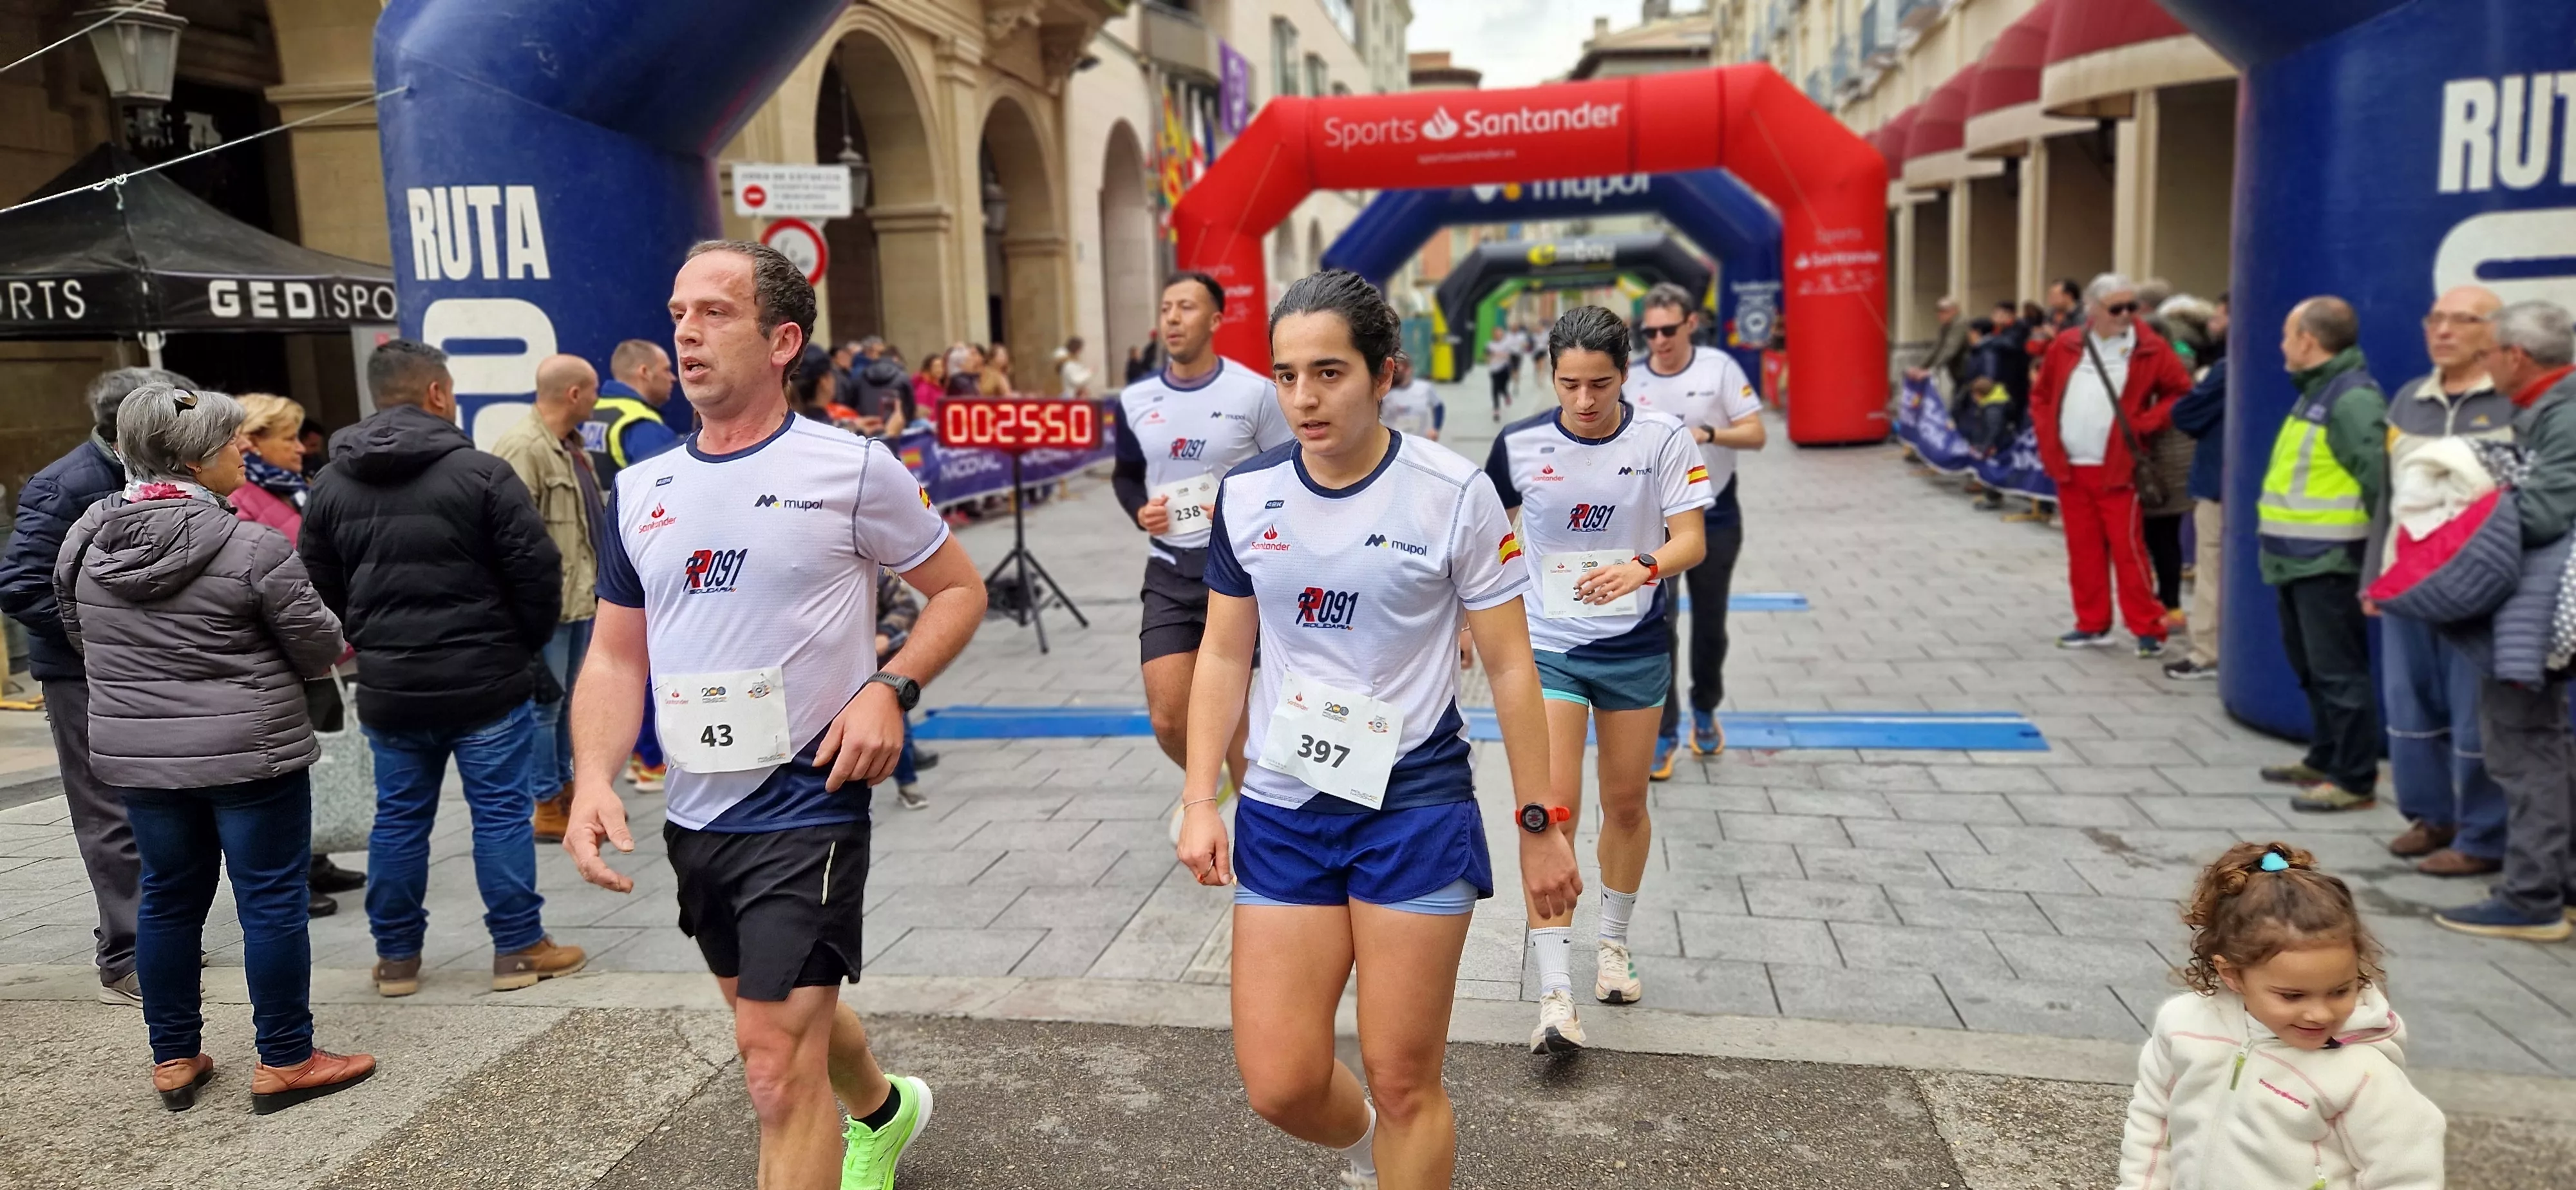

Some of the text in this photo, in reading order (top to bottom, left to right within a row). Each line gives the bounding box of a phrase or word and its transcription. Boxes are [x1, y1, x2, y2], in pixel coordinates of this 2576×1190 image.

[1324, 102, 1623, 151] Sports Santander
[406, 185, 551, 281] RUTA
[0, 279, 86, 319] RTS
[784, 499, 824, 511] mupol
[1175, 505, 1201, 521] 238
[638, 516, 677, 533] Santander
[1251, 542, 1291, 551] Santander
[1392, 540, 1428, 556] mupol
[1287, 699, 1309, 711] Santander
[1324, 701, 1349, 716] 200
[701, 724, 734, 747] 43
[1297, 734, 1351, 768] 397
